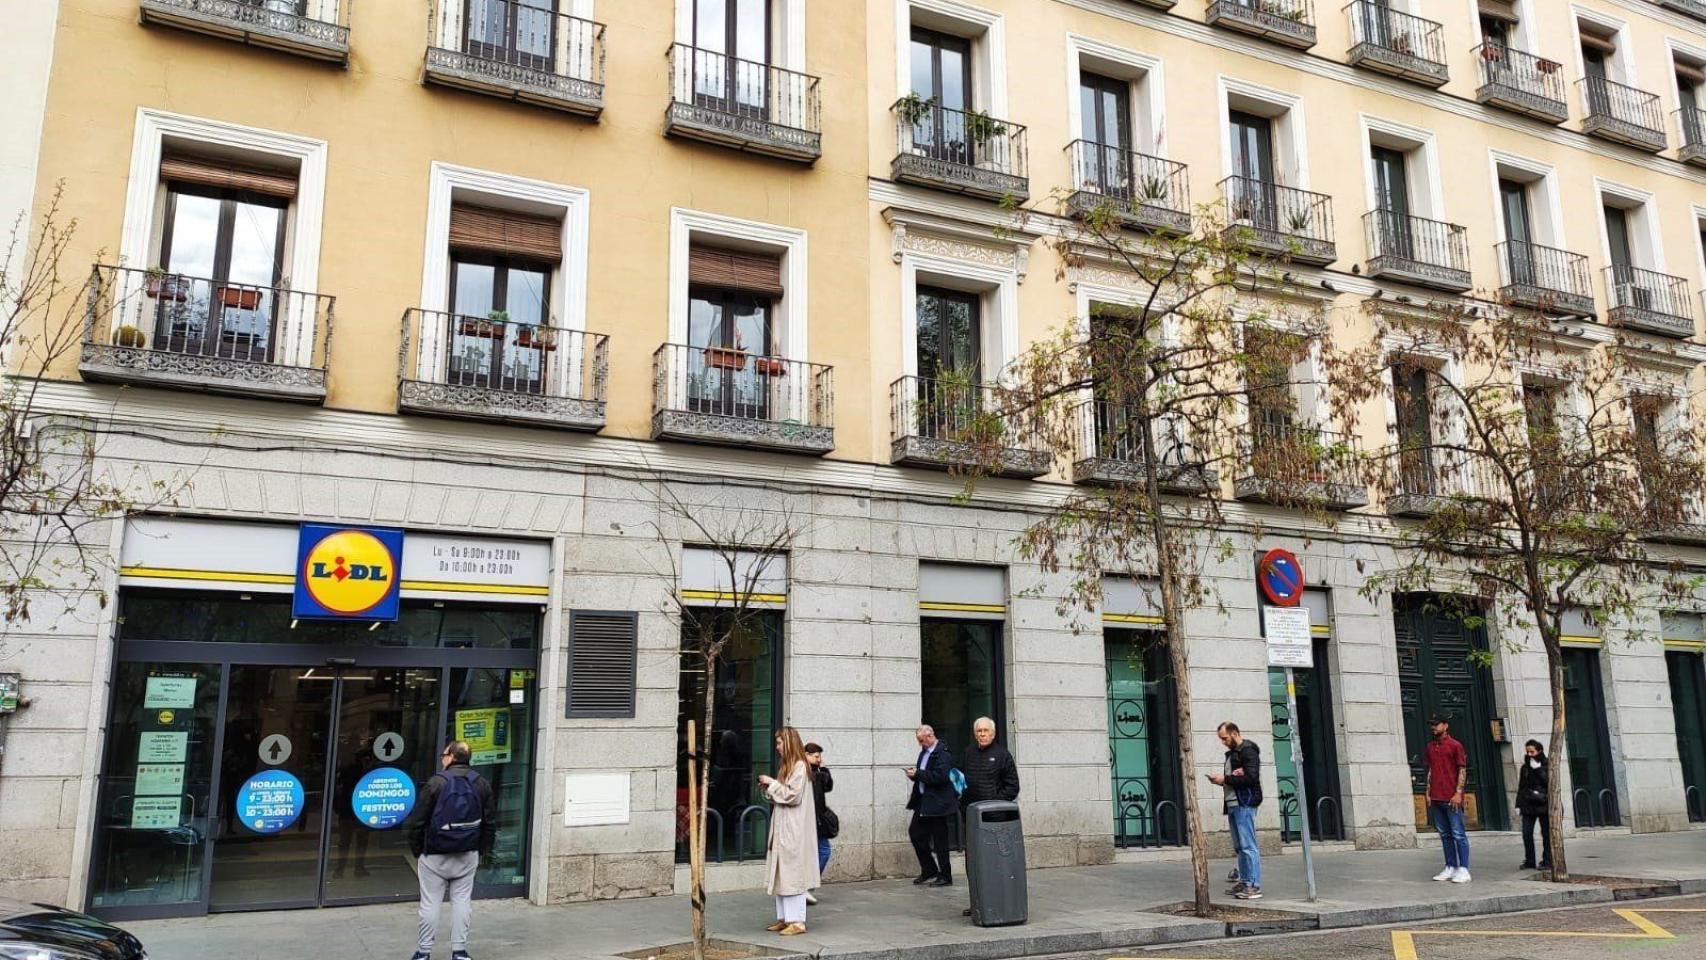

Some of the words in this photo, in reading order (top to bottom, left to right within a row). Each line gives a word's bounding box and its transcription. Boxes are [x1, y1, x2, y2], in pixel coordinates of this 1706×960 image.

[250, 780, 294, 789] HORARIO
[358, 789, 410, 798] DOMINGOS
[361, 803, 405, 812] FESTIVOS
